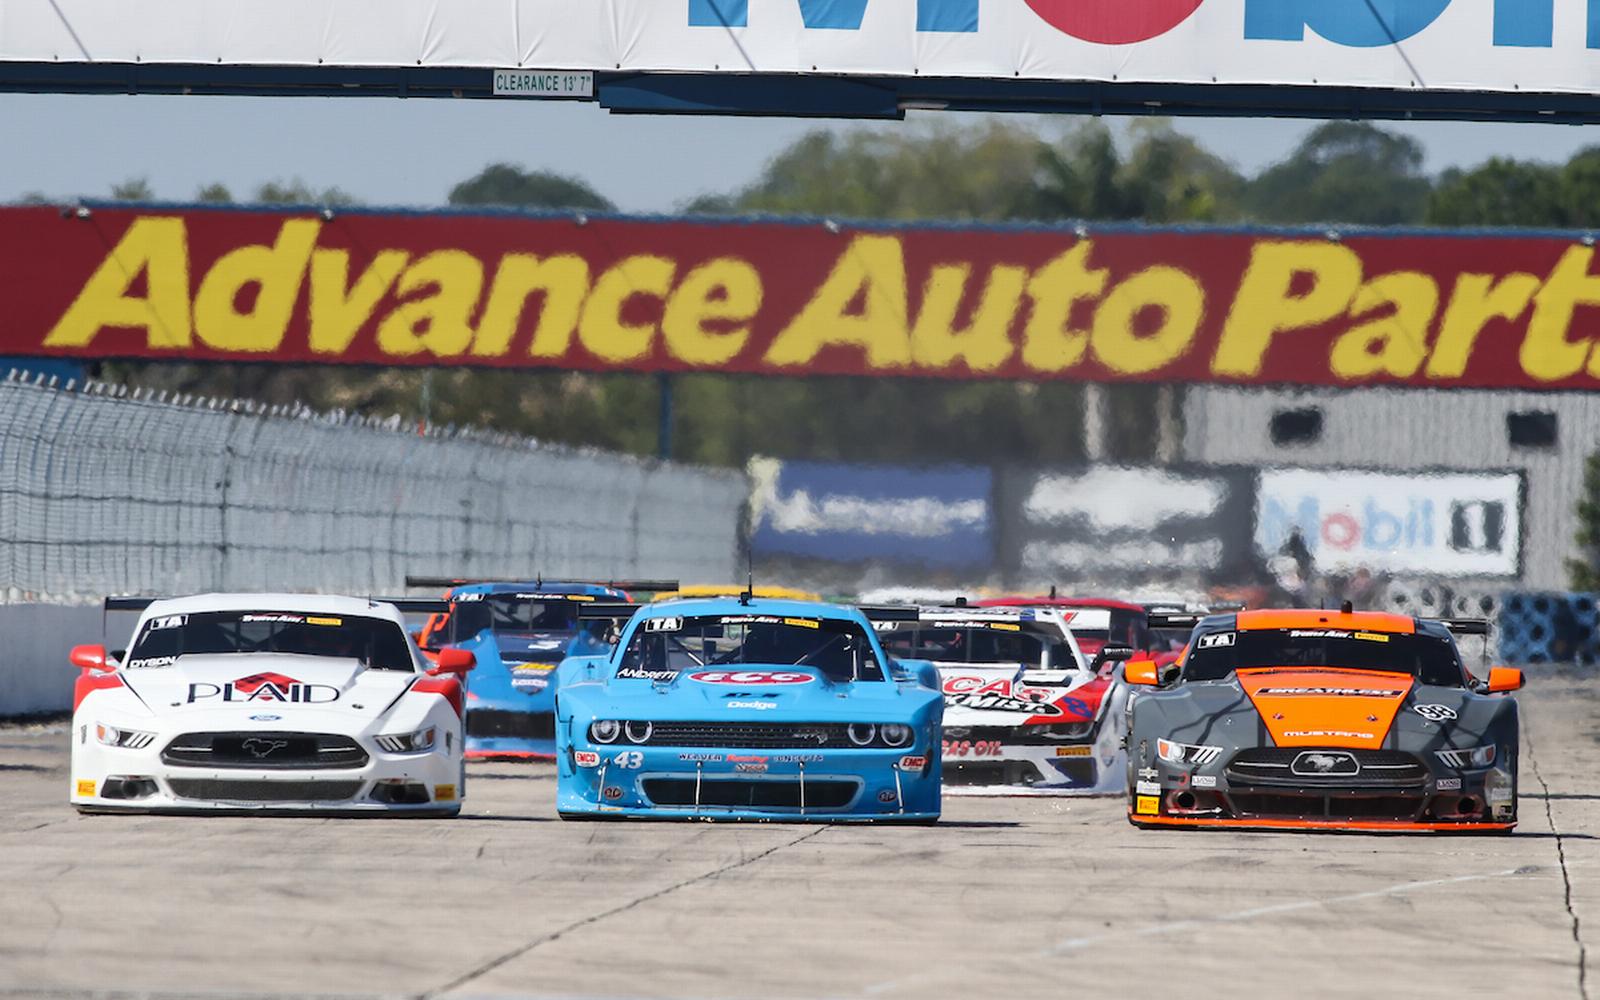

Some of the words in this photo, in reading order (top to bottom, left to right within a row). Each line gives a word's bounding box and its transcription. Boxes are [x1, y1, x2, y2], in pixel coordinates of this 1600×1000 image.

[496, 74, 559, 91] CLEARANCE
[563, 76, 577, 91] 13'
[44, 216, 763, 367] Advance
[765, 232, 1206, 376] Auto
[1210, 240, 1600, 381] Part
[1262, 495, 1435, 551] Mobil
[155, 617, 182, 629] TA
[651, 618, 677, 630] TA
[1204, 634, 1231, 646] TA
[130, 656, 175, 668] DYSON
[616, 668, 679, 680] ANDRETTI
[187, 683, 340, 703] PLAID
[942, 676, 1052, 703] CAS
[727, 701, 777, 710] Dodge
[1283, 731, 1375, 739] MUSTANG
[974, 740, 1003, 756] OIL
[613, 751, 644, 769] 43
